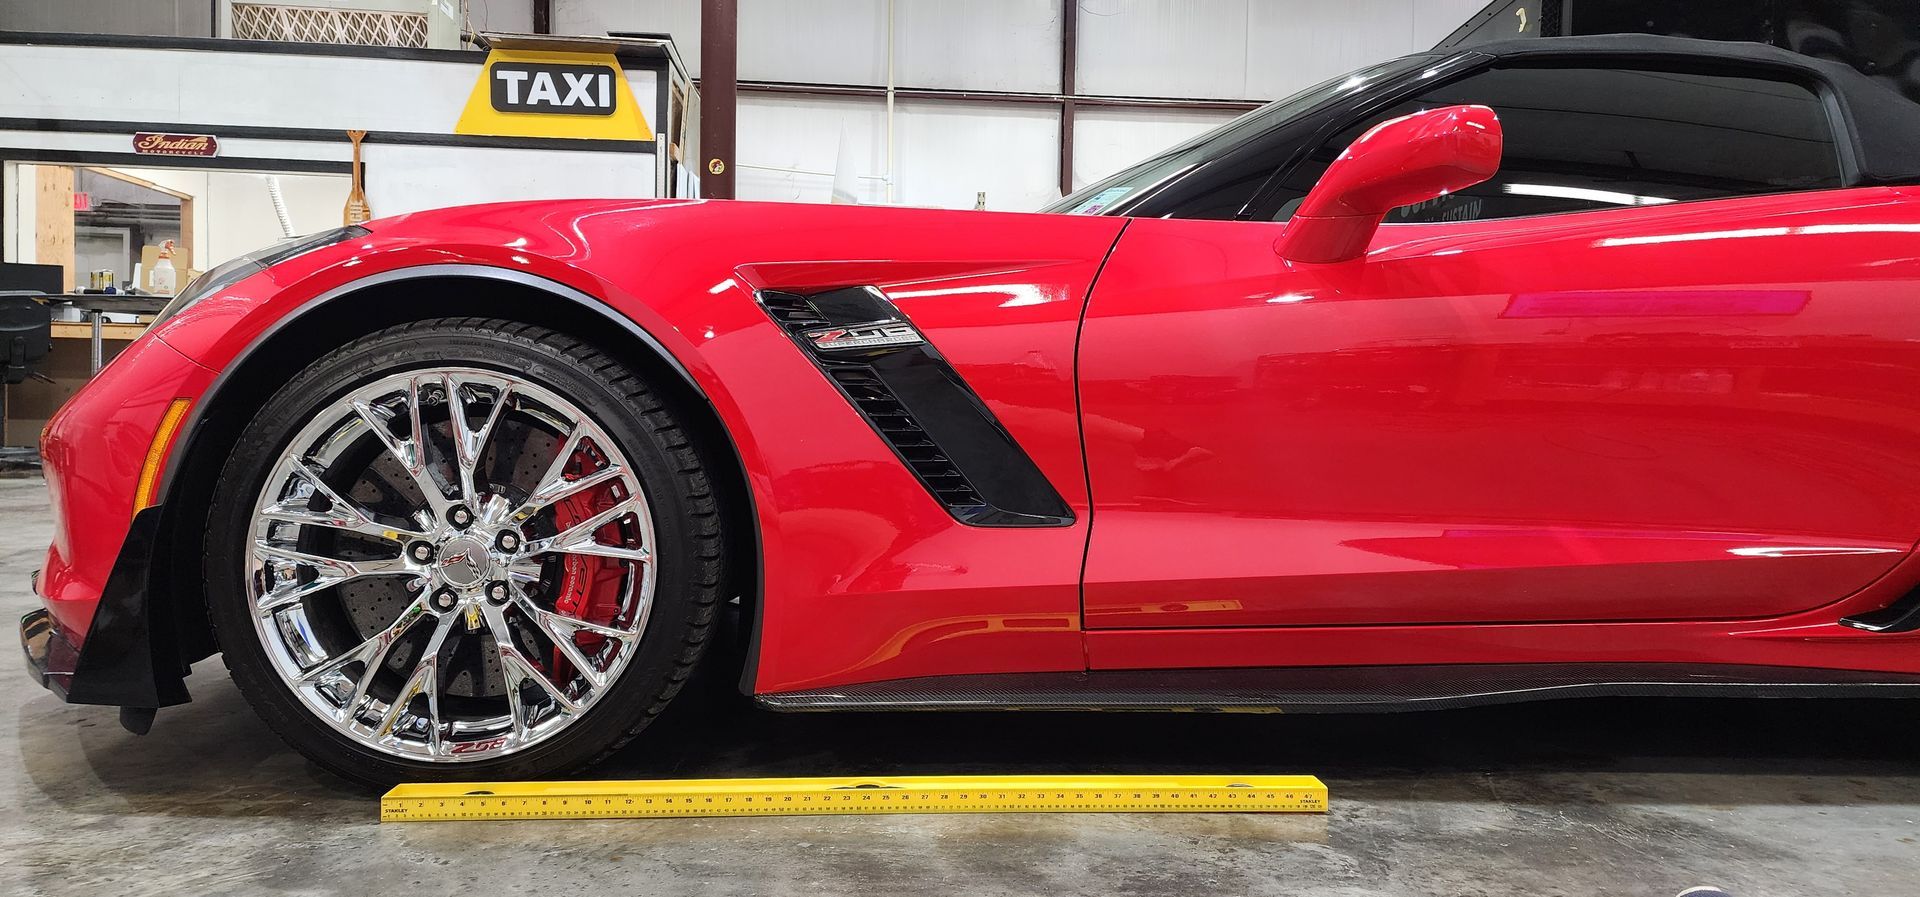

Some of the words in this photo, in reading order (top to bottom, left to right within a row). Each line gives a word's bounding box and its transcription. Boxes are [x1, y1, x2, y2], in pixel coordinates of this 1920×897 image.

[496, 70, 610, 108] TAXI
[138, 134, 208, 151] Indian
[808, 323, 915, 343] Z06
